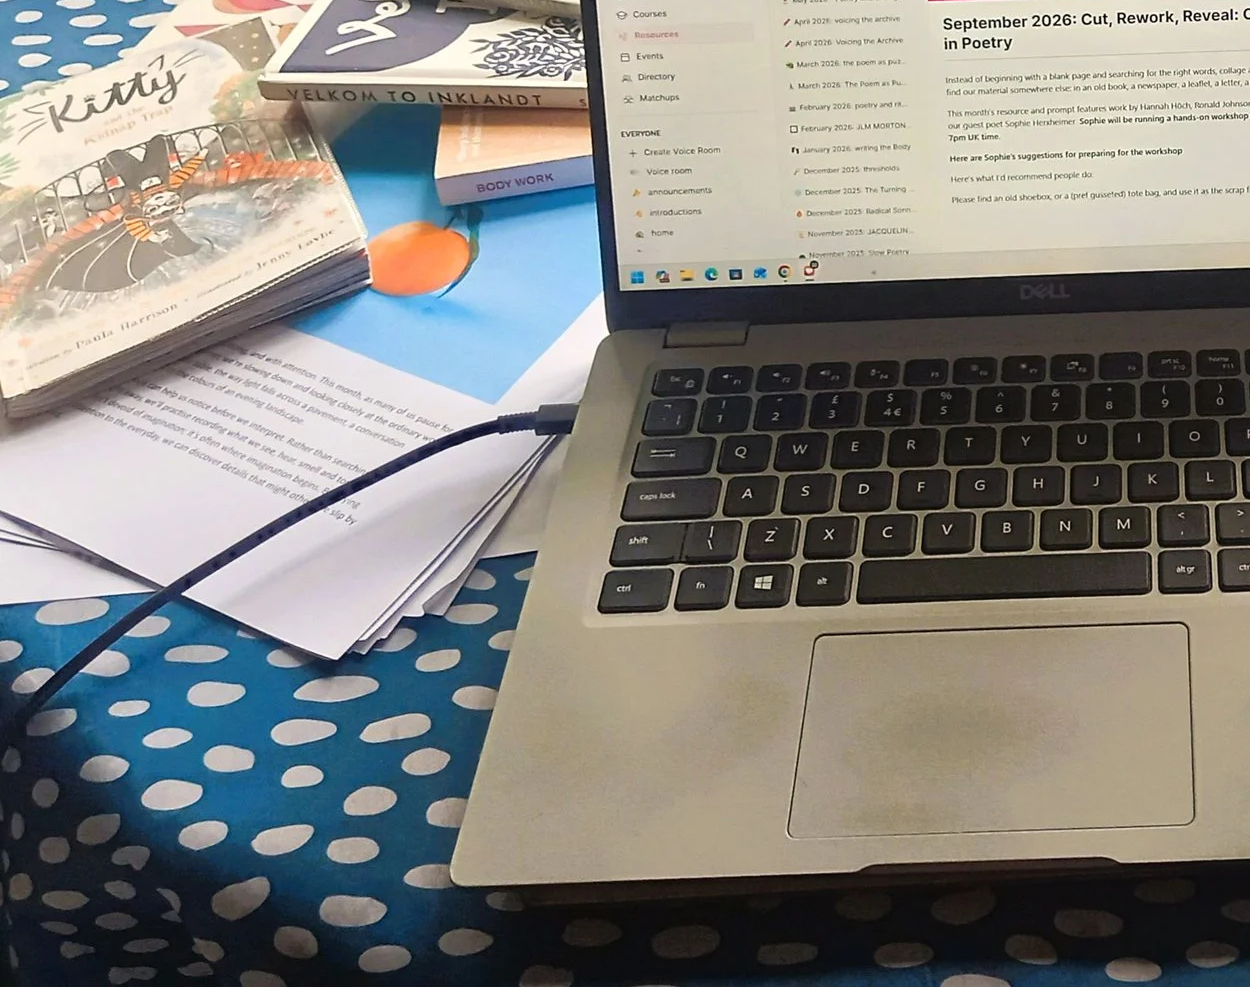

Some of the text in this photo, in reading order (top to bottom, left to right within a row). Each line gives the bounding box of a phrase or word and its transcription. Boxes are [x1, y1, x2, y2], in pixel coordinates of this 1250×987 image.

[633, 9, 667, 19] Courses
[943, 16, 1028, 31] September
[1031, 13, 1077, 27] 2026:
[1081, 13, 1113, 27] Cut,
[1117, 10, 1179, 25] Rework,
[1183, 9, 1239, 22] Reveal:
[635, 30, 679, 39] Resources
[944, 36, 1013, 51] in Poetry
[636, 52, 664, 61] Events
[638, 73, 676, 82] Directory
[48, 69, 187, 133] Kitty
[285, 88, 543, 107] VELKOM TO INKLANDT
[640, 93, 680, 103] Matchups
[84, 104, 174, 146] Kidnap Trap
[1079, 116, 1106, 127] Sophie
[1107, 116, 1121, 124] will
[1123, 115, 1133, 123] be
[1134, 114, 1165, 125] running
[1173, 113, 1210, 122] hands-on
[1211, 111, 1249, 123] workshop
[621, 130, 661, 138] EVERYONE
[644, 146, 721, 156] Create Voice Room
[949, 147, 1183, 163] Here are Sophie's suggestions for preparing for the workshop
[476, 172, 554, 193] BODY WORK
[648, 187, 712, 196] announcements
[650, 207, 702, 216] introductions
[651, 229, 674, 237] home
[1020, 283, 1071, 300] DELL
[76, 328, 115, 351] Paula
[121, 303, 178, 333] Harrison
[265, 355, 282, 366] with
[319, 376, 336, 388] This
[337, 383, 362, 400] month,
[363, 396, 374, 405] as
[375, 399, 396, 413] many
[397, 407, 406, 416] of
[406, 410, 416, 419] us
[416, 414, 441, 430] pause
[441, 423, 454, 434] for
[337, 401, 426, 440] closely at the ordinary
[735, 444, 808, 458] Q W
[639, 491, 676, 501] caps lock
[628, 536, 648, 545] shift
[616, 581, 705, 593] ctrl fn
